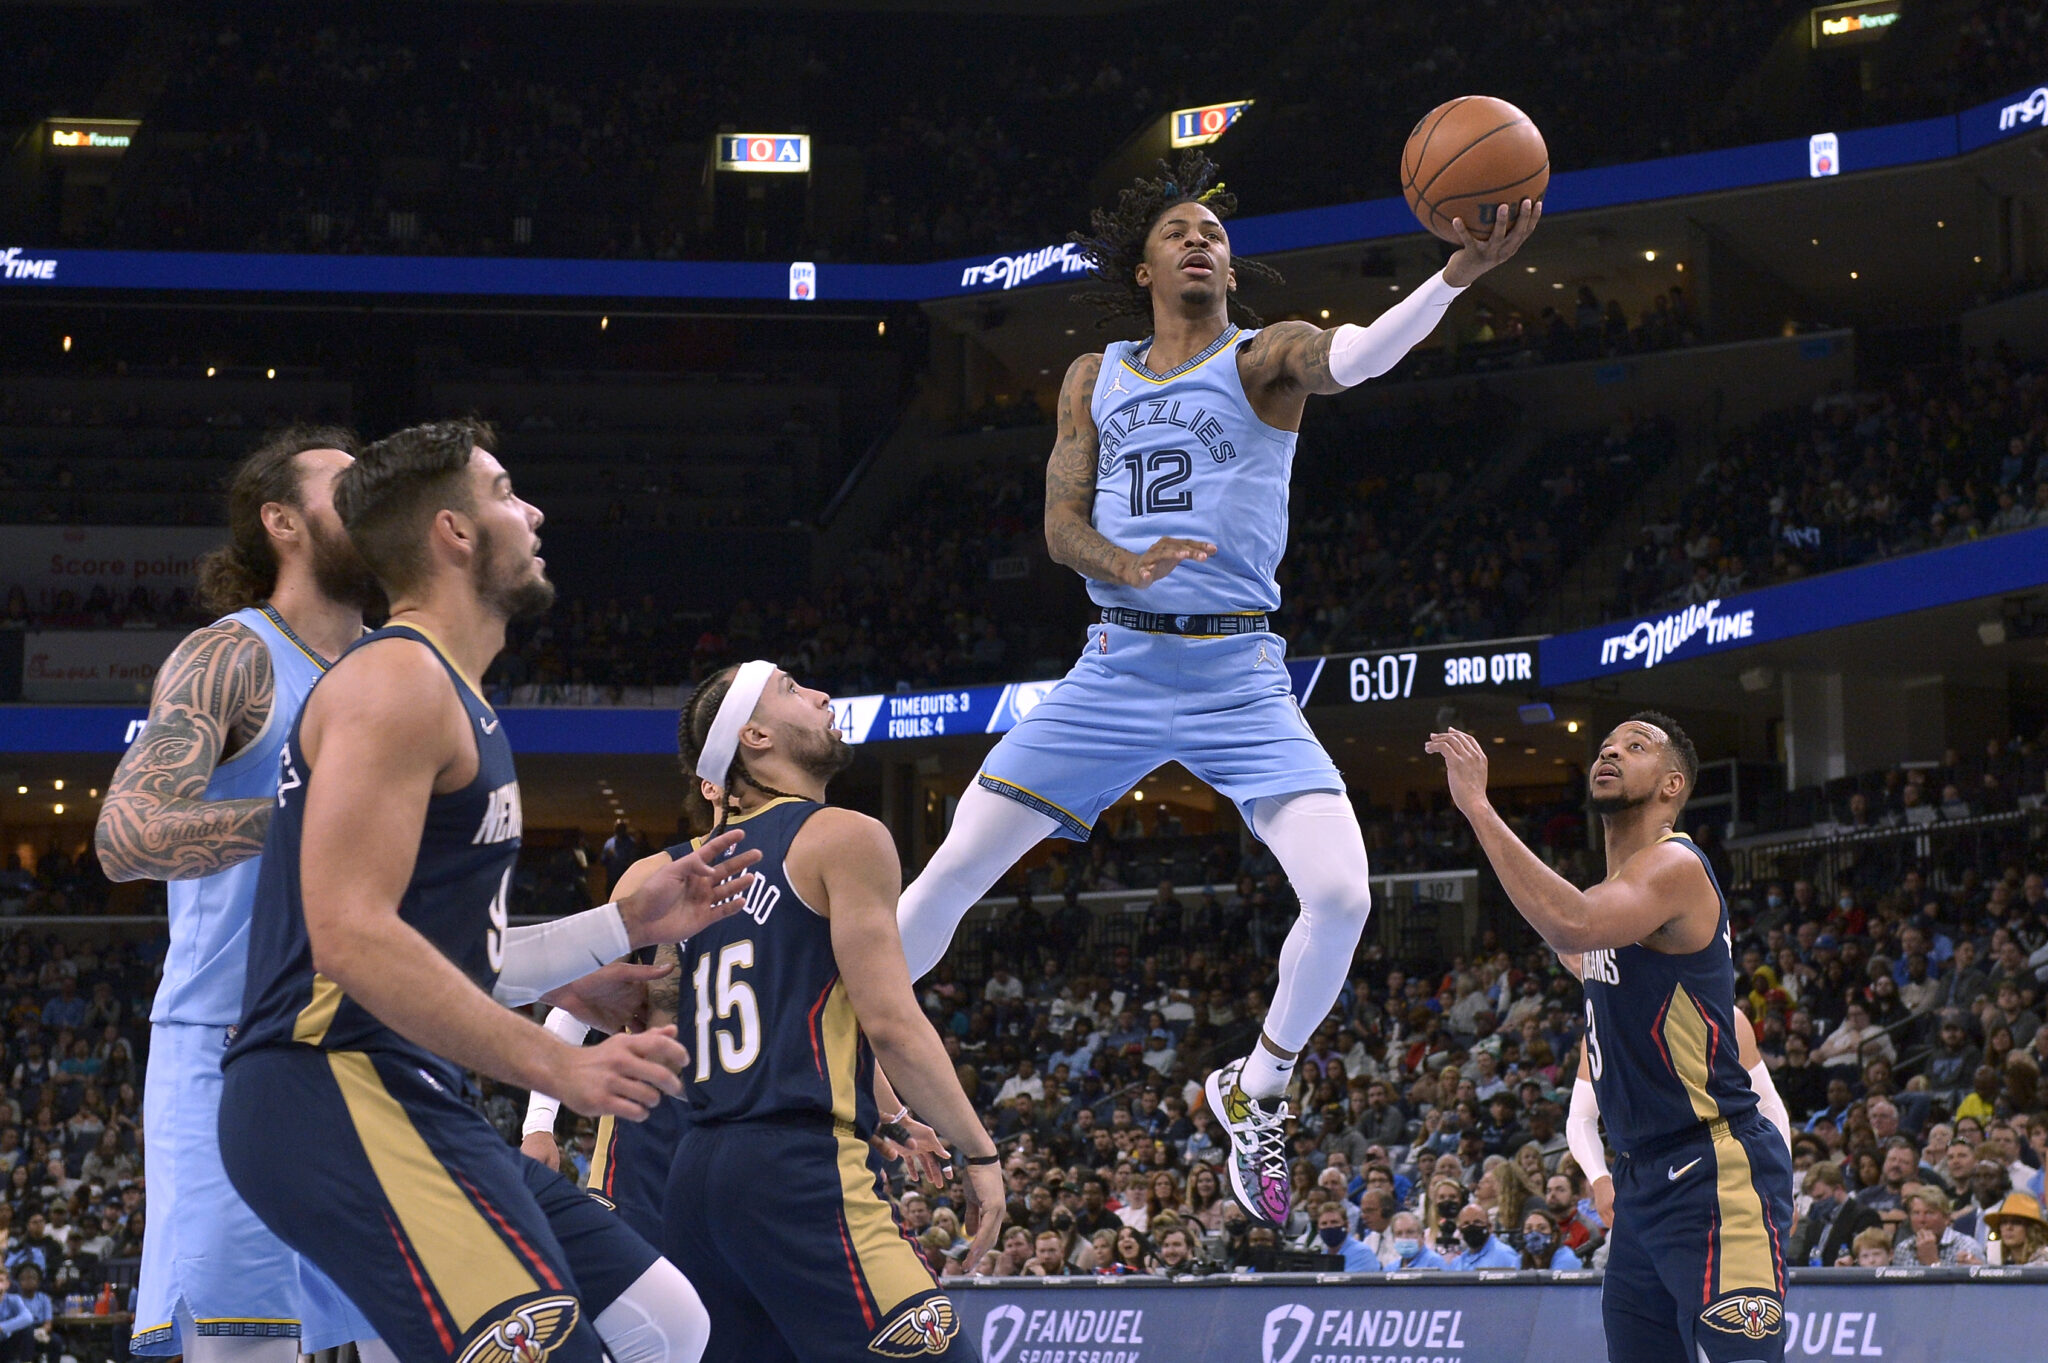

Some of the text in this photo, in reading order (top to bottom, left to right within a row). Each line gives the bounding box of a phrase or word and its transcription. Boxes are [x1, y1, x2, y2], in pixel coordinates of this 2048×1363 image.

[5, 260, 57, 279] TIME
[990, 243, 1076, 290] Miller
[1099, 399, 1237, 476] GRIZZLIES
[1124, 448, 1193, 517] 12
[51, 554, 125, 576] Score
[1632, 599, 1721, 668] Miller
[1705, 609, 1755, 645] TIME
[1350, 652, 1532, 702] 6:07 3RD QTR
[888, 692, 970, 717] TIMEOUTS: 3
[888, 716, 945, 738] FOULS: 4
[693, 938, 761, 1083] 15
[1585, 997, 1603, 1081] 3
[1024, 1309, 1144, 1344] FANDUEL
[1315, 1309, 1465, 1348] FANDUEL
[1784, 1311, 1884, 1356] DUEL
